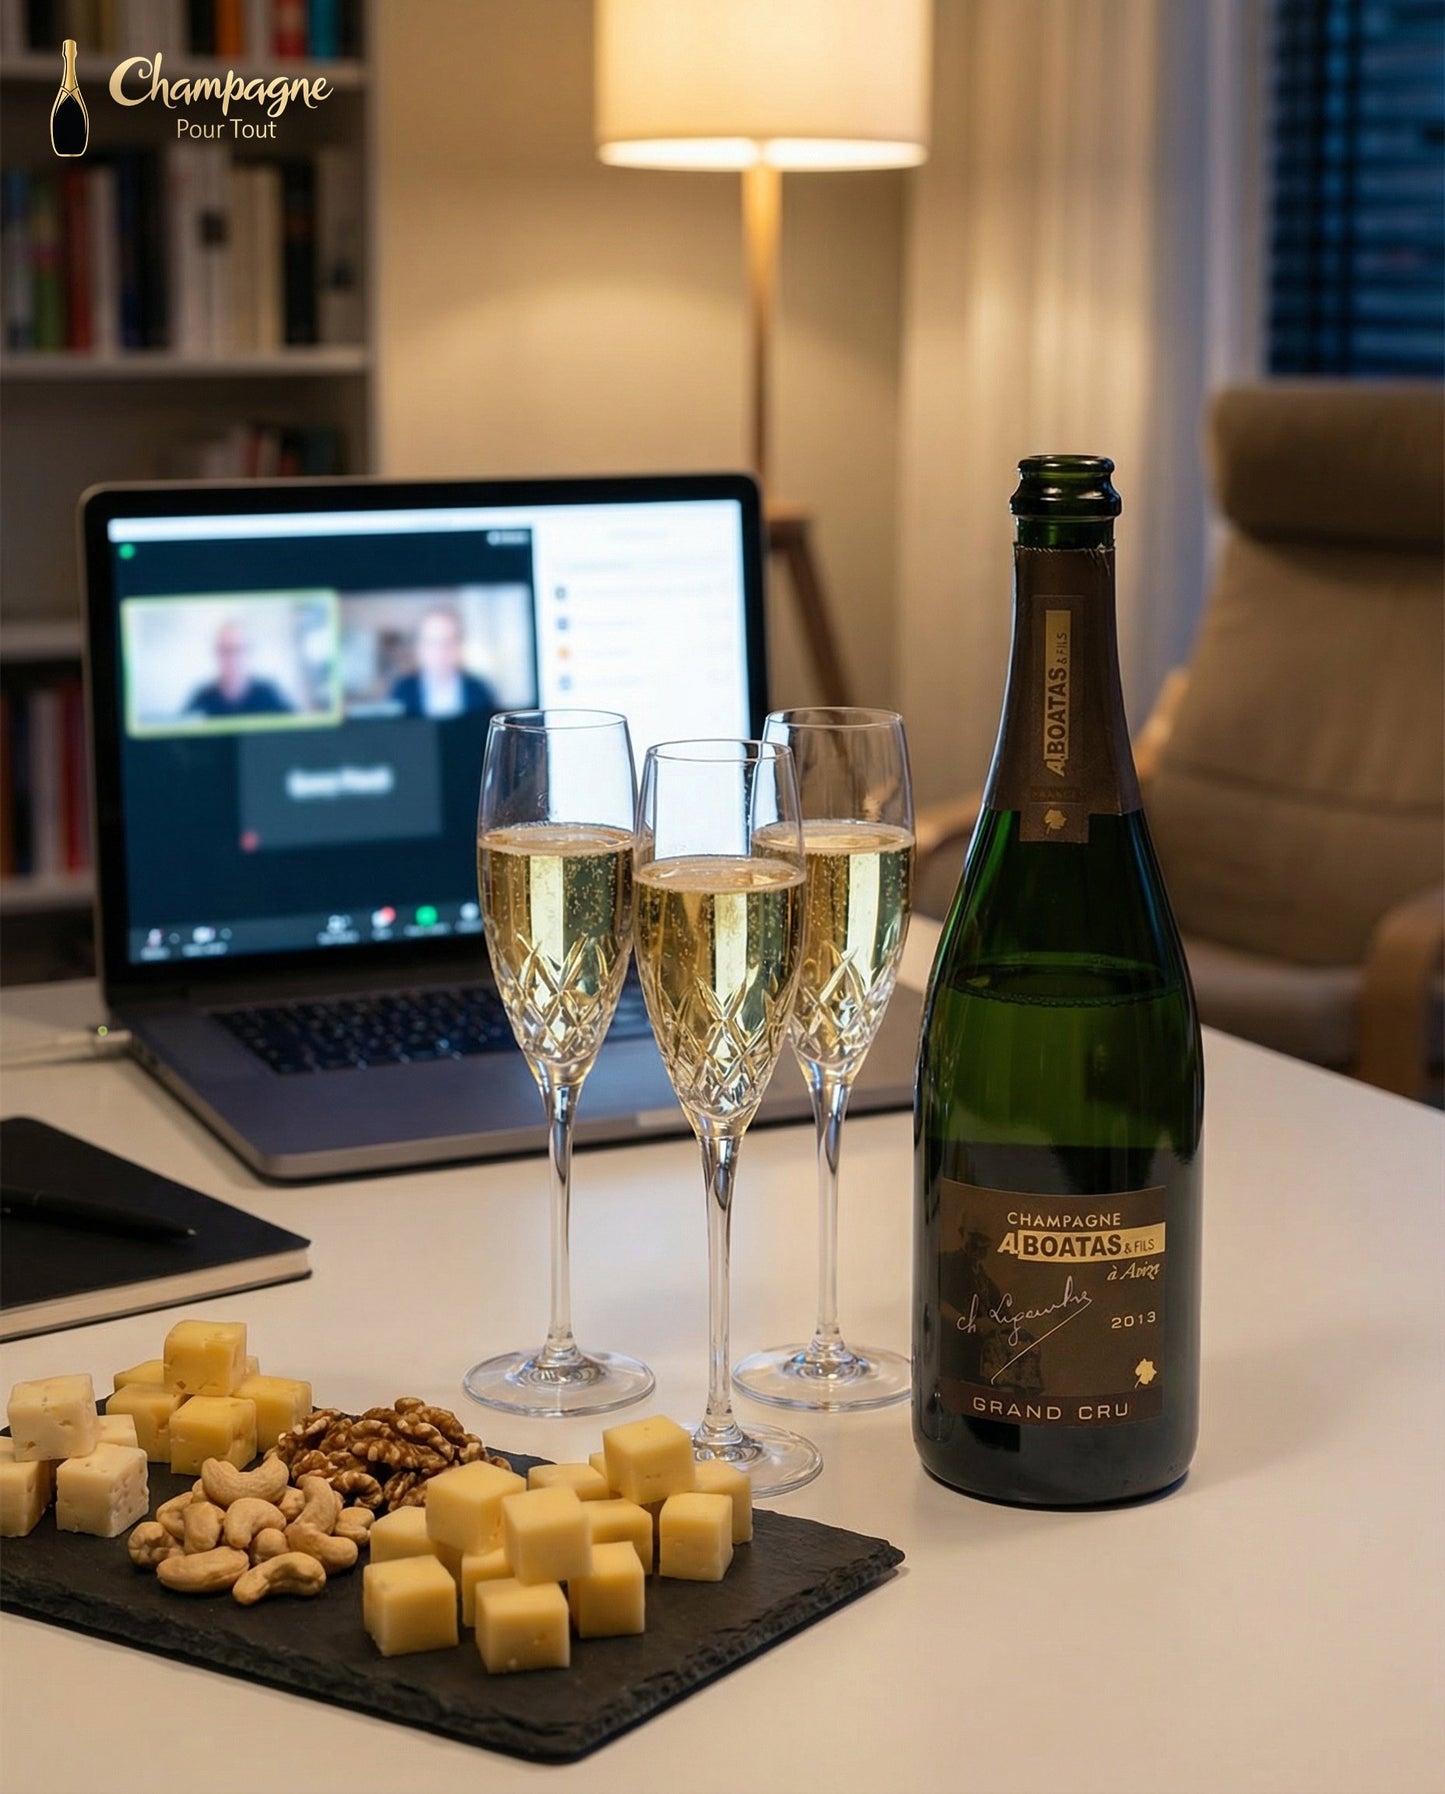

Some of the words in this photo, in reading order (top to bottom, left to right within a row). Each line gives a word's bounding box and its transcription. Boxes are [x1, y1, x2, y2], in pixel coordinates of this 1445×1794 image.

[1006, 1211, 1122, 1229] CHAMPAGNE
[1123, 1242, 1133, 1255] &
[1134, 1238, 1155, 1254] FILS
[1106, 1264, 1118, 1281] à
[1110, 1310, 1157, 1329] 2013
[972, 1396, 1062, 1421] GRAND
[1078, 1402, 1129, 1421] CRU
